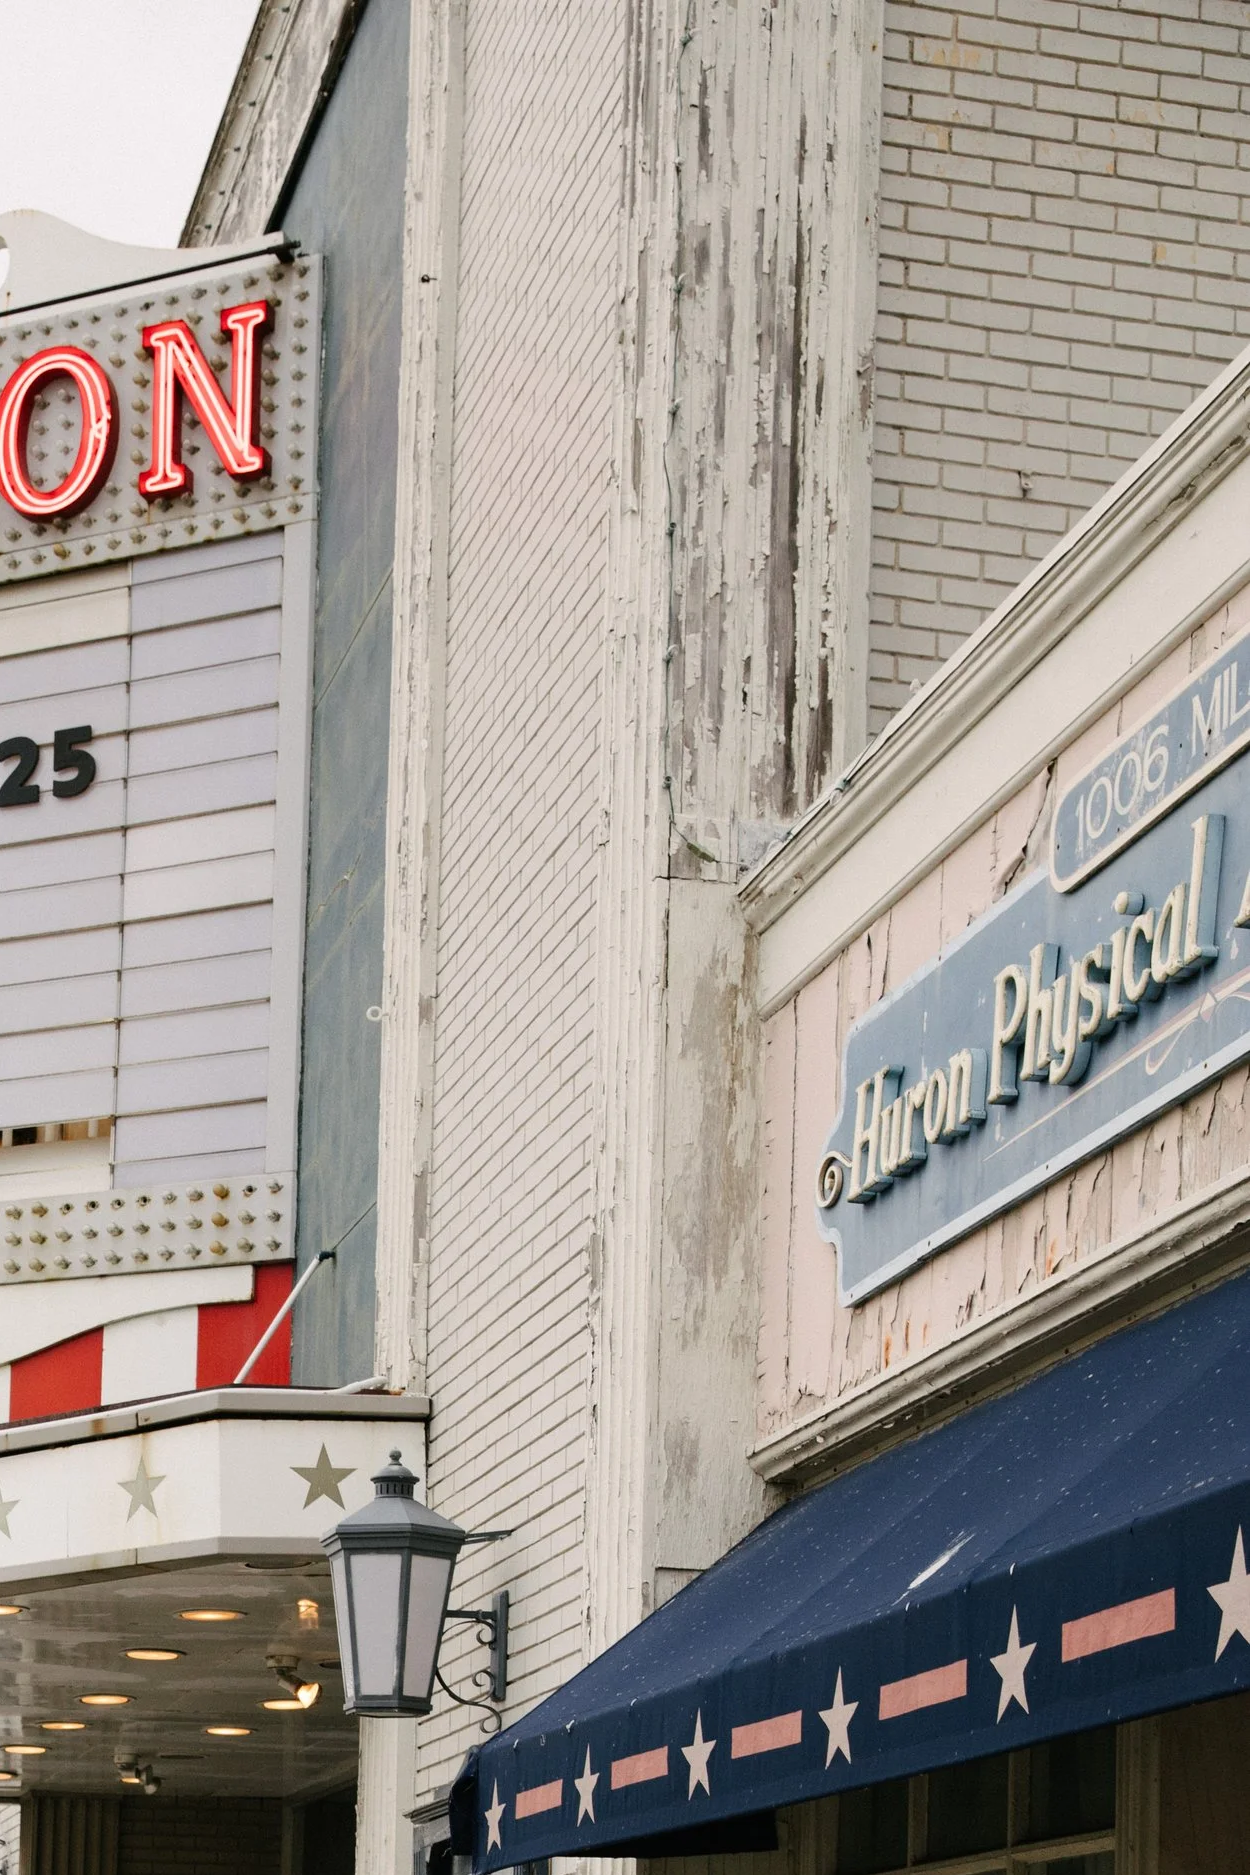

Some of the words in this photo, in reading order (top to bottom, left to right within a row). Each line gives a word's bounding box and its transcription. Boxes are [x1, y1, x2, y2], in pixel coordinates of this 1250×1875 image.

[1075, 724, 1170, 842] 1006
[1190, 660, 1250, 759] MIL
[847, 1046, 988, 1205] Huron
[987, 813, 1227, 1105] Physical
